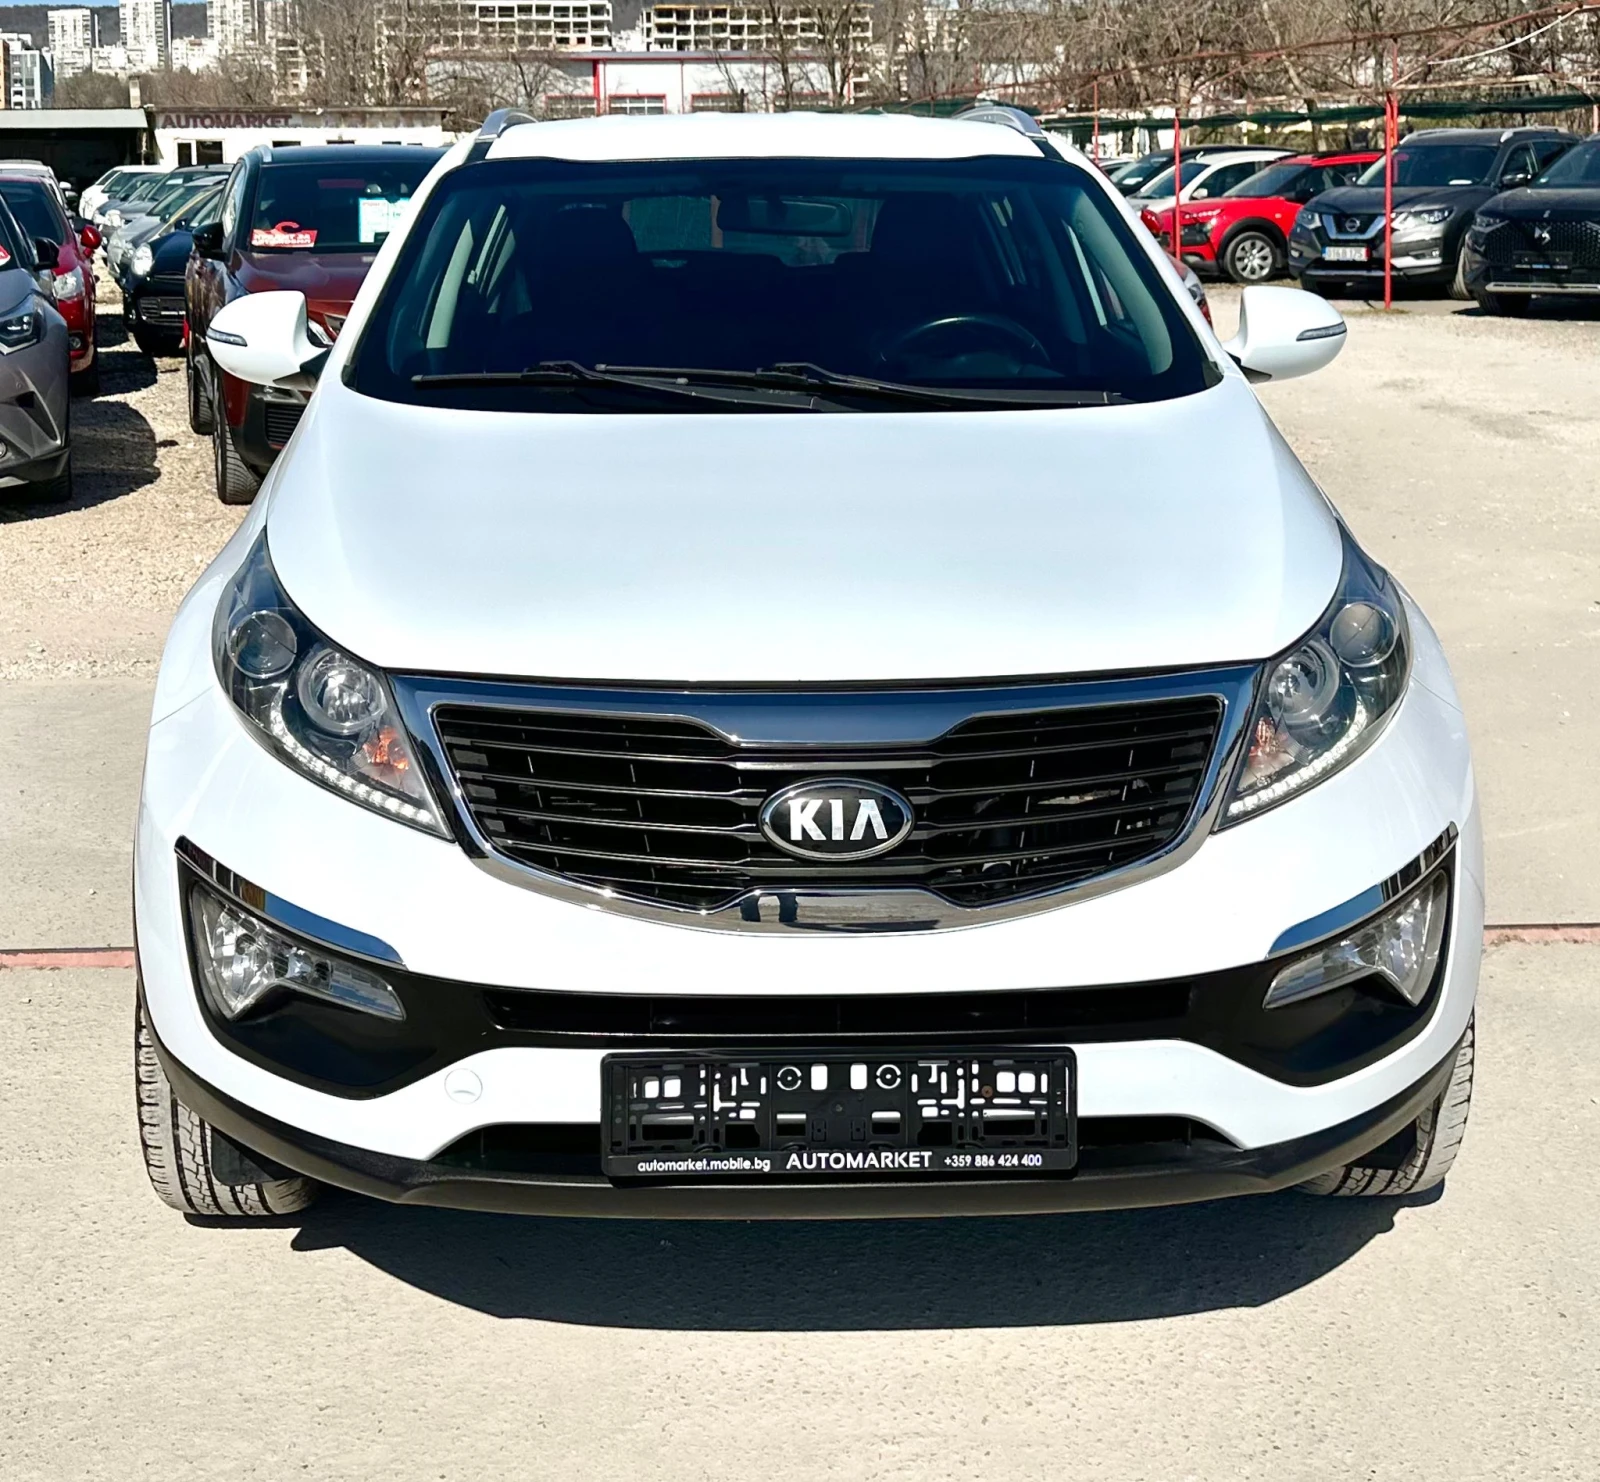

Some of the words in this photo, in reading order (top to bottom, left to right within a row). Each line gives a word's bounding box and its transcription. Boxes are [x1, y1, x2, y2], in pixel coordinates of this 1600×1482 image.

[161, 114, 293, 129] AUTOMARKET
[788, 798, 888, 841] KIA
[637, 1157, 771, 1173] automarket.mobile.bg
[785, 1151, 933, 1170] AUTOMARKET
[944, 1154, 972, 1167] +359
[974, 1154, 995, 1167] 886
[998, 1153, 1018, 1167] 424
[1021, 1153, 1042, 1166] 400
